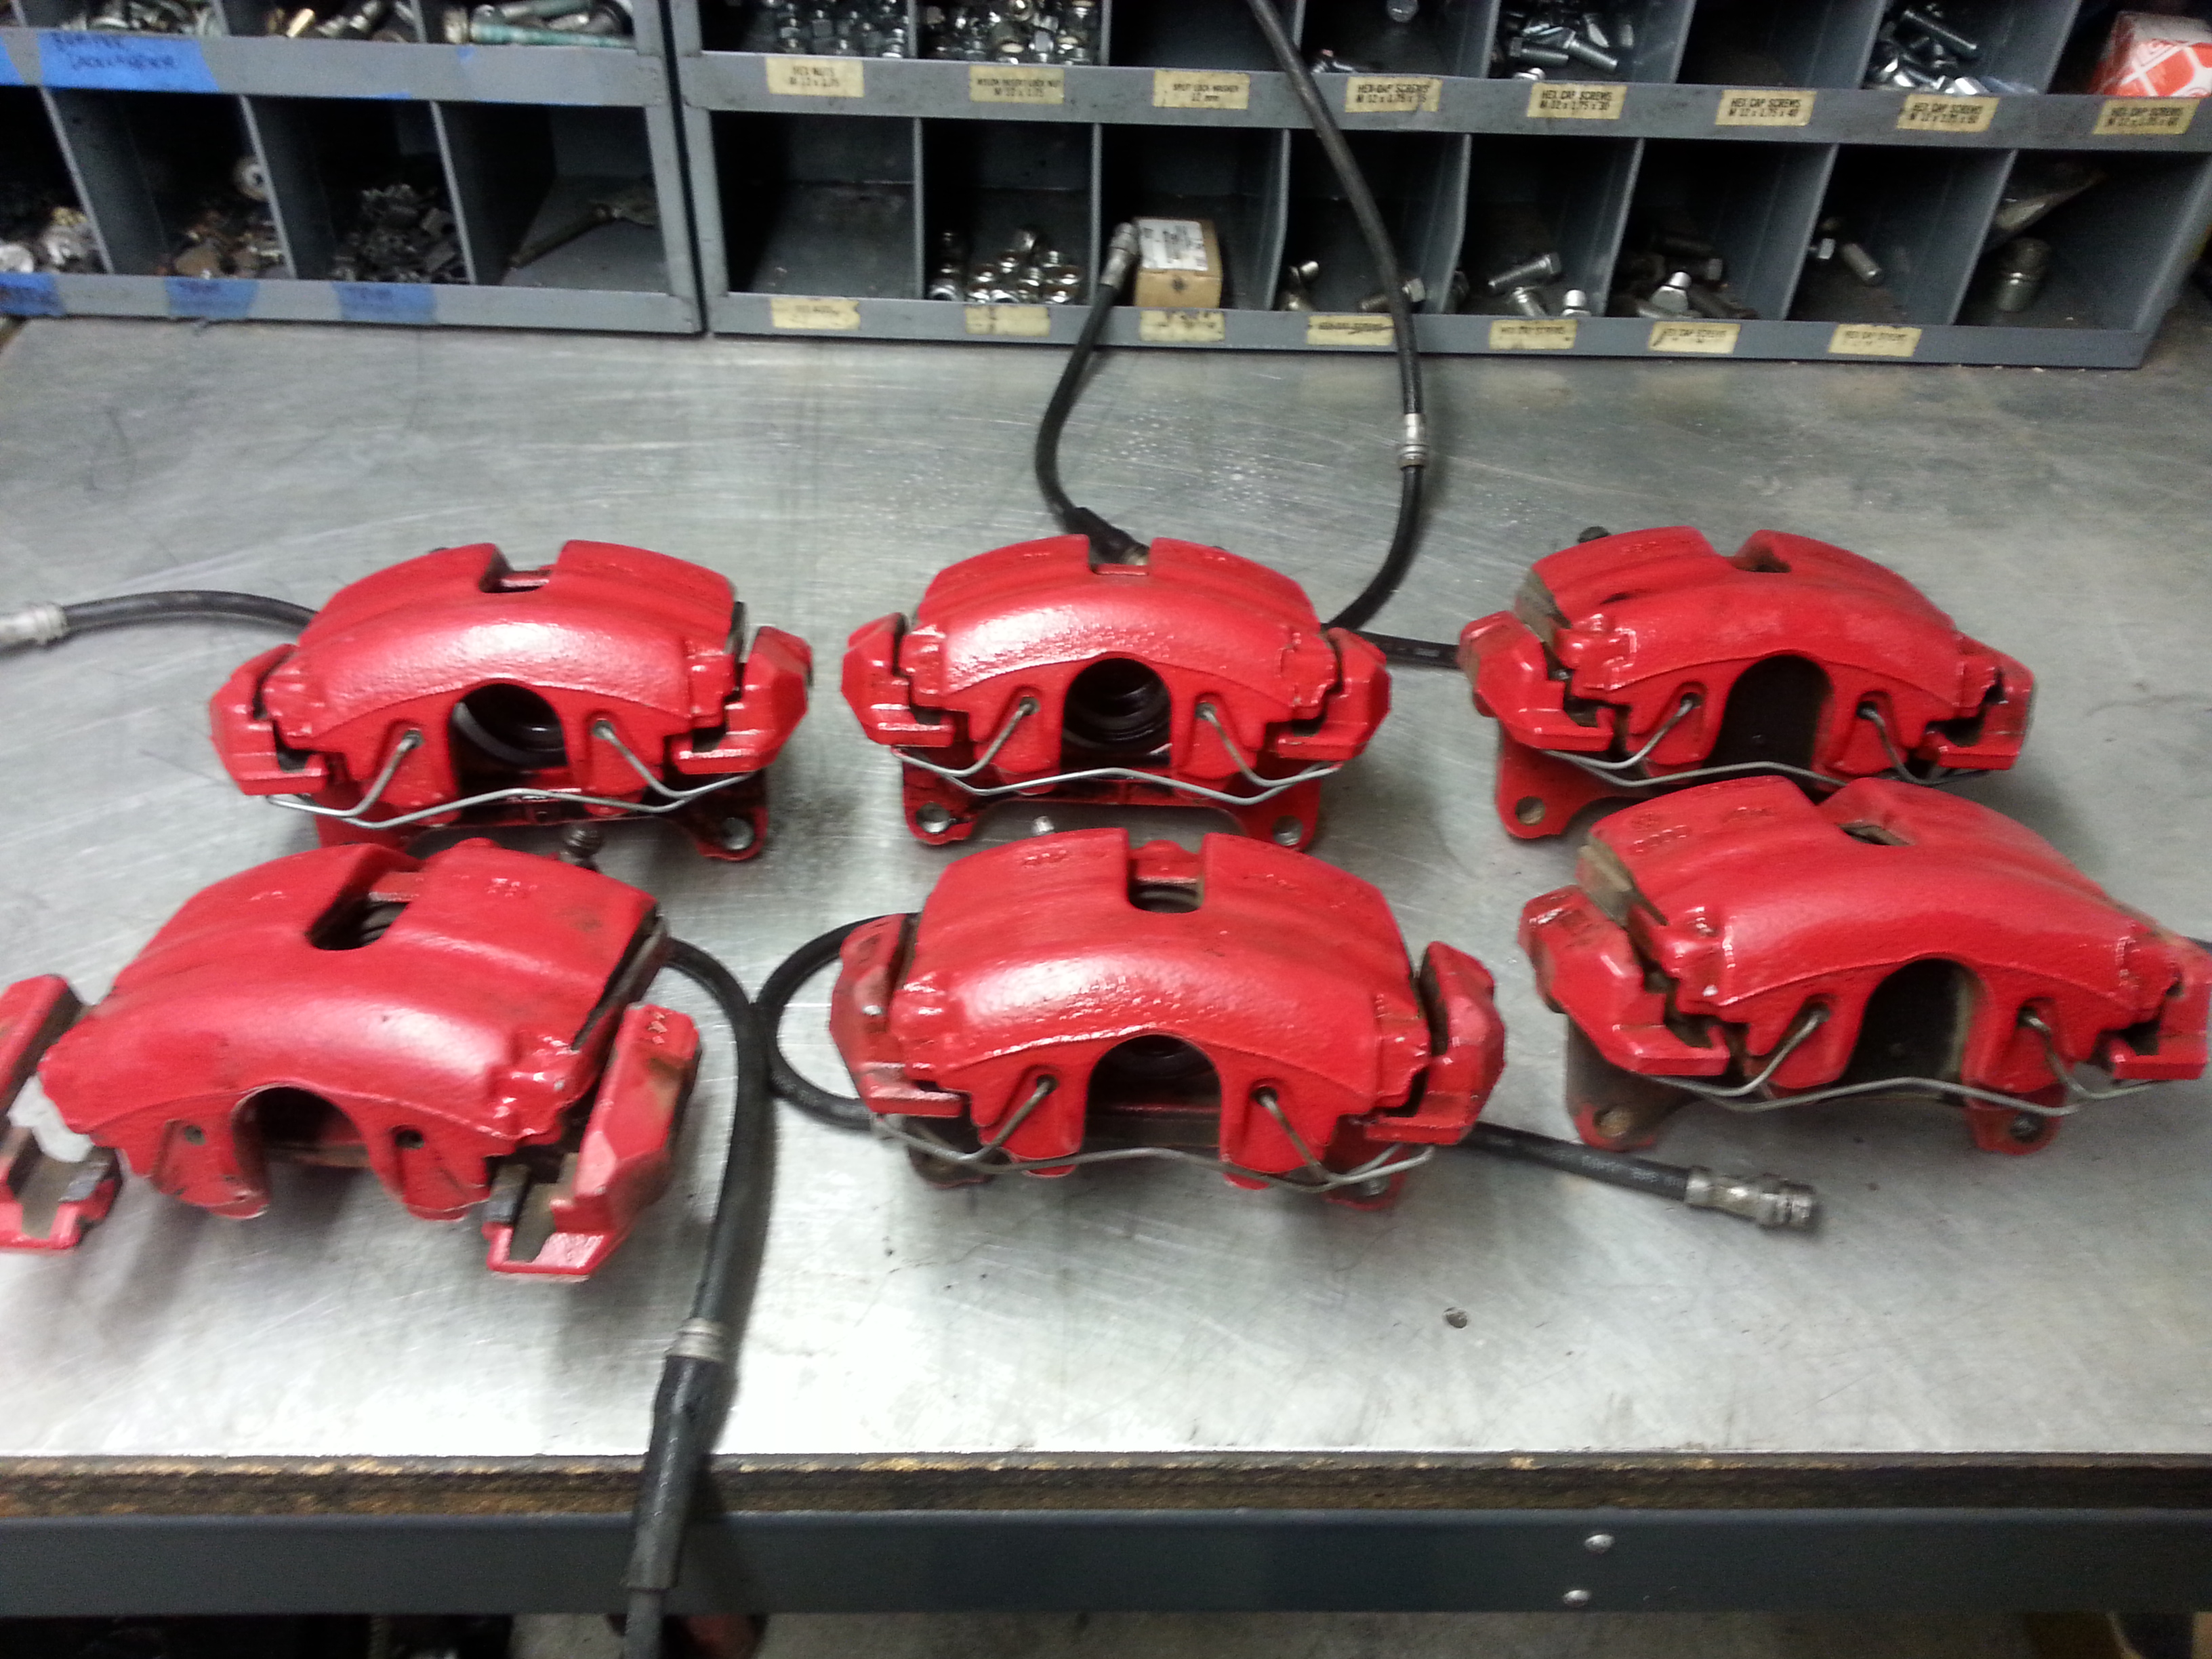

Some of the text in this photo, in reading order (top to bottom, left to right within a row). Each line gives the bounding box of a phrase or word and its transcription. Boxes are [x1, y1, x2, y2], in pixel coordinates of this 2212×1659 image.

[1542, 90, 1557, 99] HEX
[1580, 91, 1613, 100] SCREWS
[1551, 100, 1561, 109] 12
[1731, 98, 1746, 107] HEX
[1768, 98, 1802, 108] SCREWS
